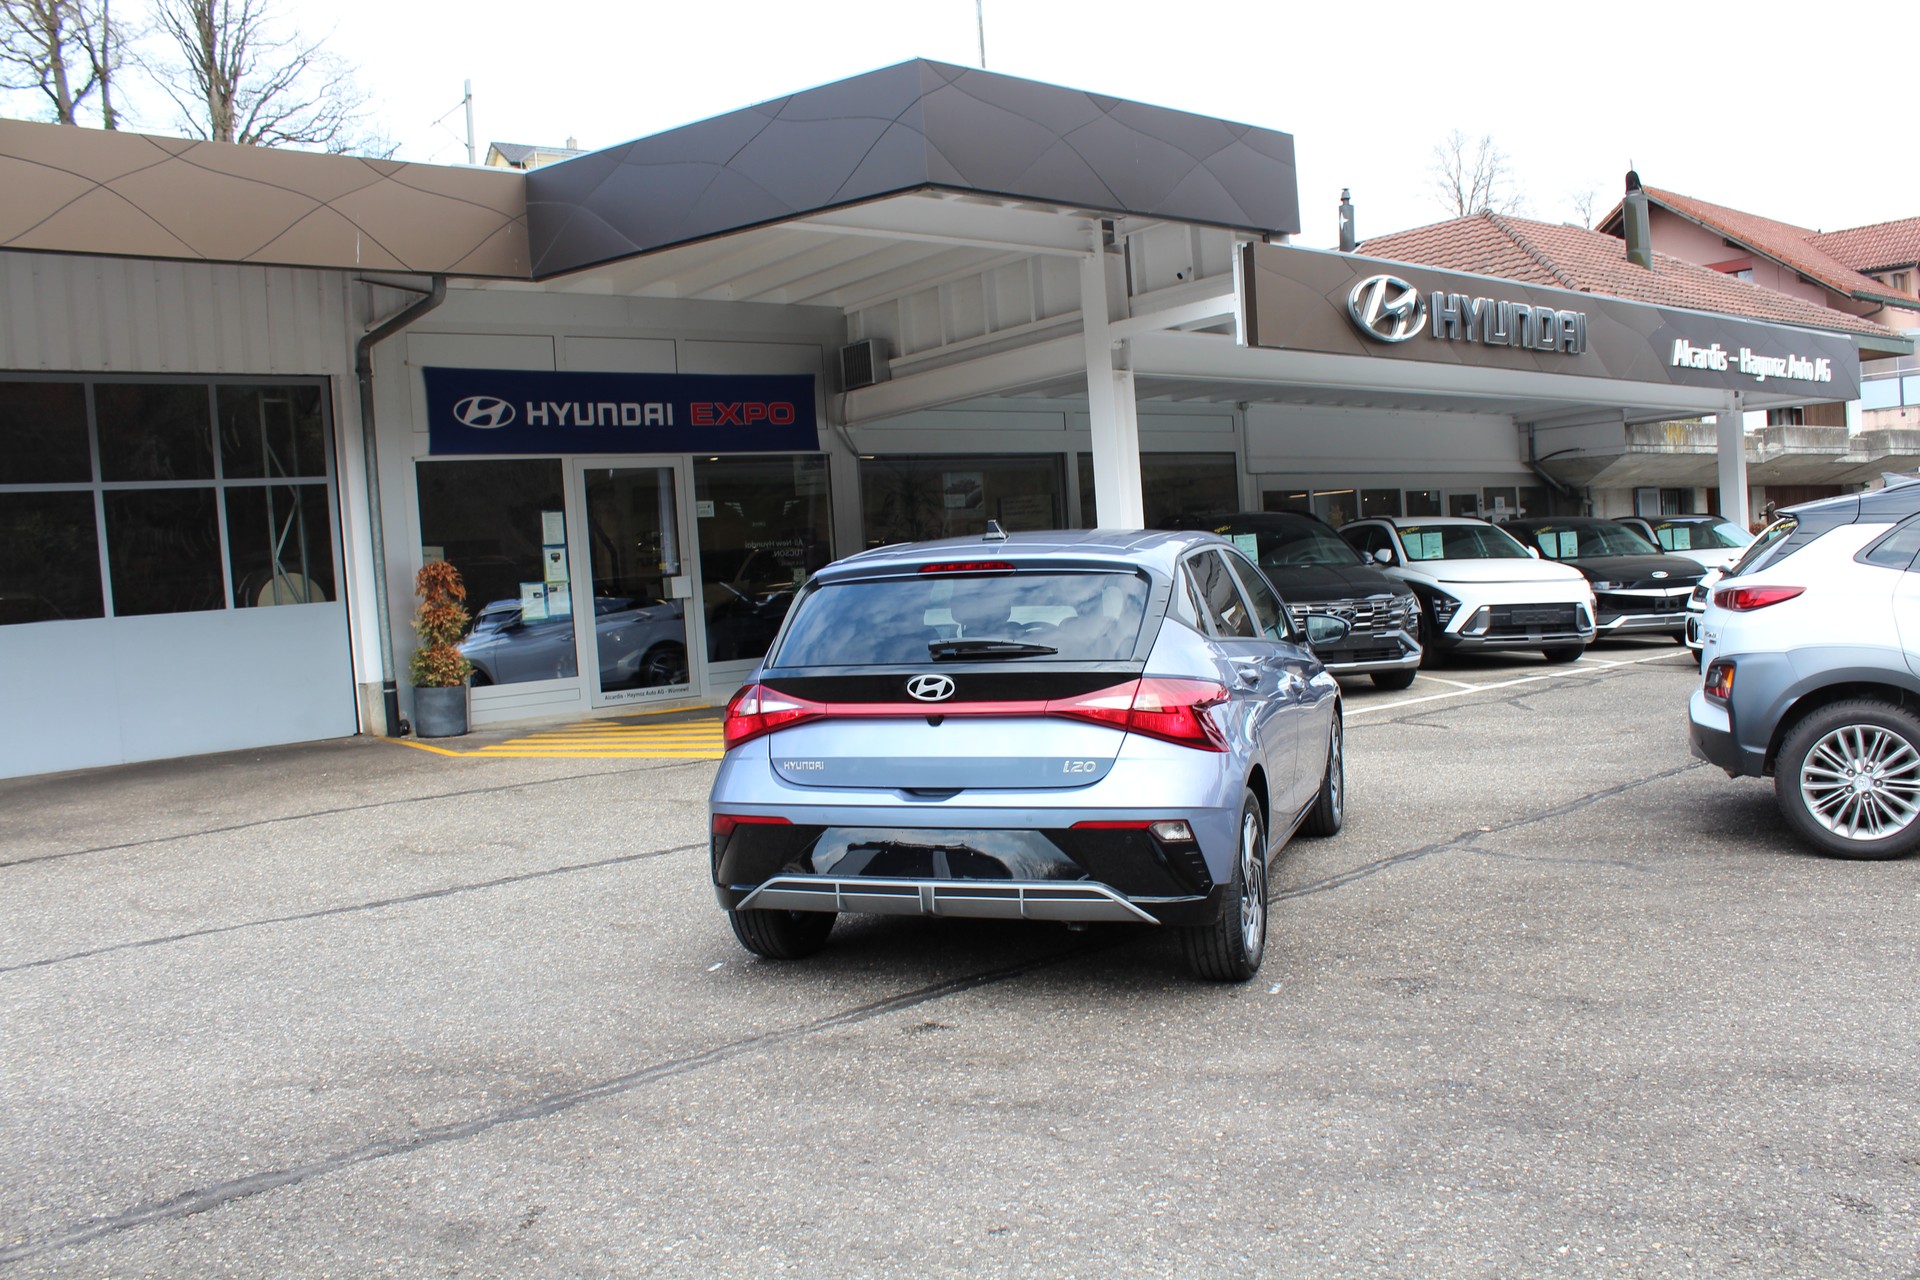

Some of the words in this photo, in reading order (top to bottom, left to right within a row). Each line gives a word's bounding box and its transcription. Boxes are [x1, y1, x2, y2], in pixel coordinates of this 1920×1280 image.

[1431, 291, 1587, 354] HYUNDAI
[1671, 338, 1727, 371] Alcardis
[1739, 347, 1786, 382] Haymoz
[1787, 353, 1814, 381] Auto
[1814, 357, 1831, 383] AG
[526, 401, 674, 426] HYUNDAI
[690, 401, 795, 426] EXPO
[783, 761, 825, 770] HYUNDAI
[1063, 760, 1097, 773] i20
